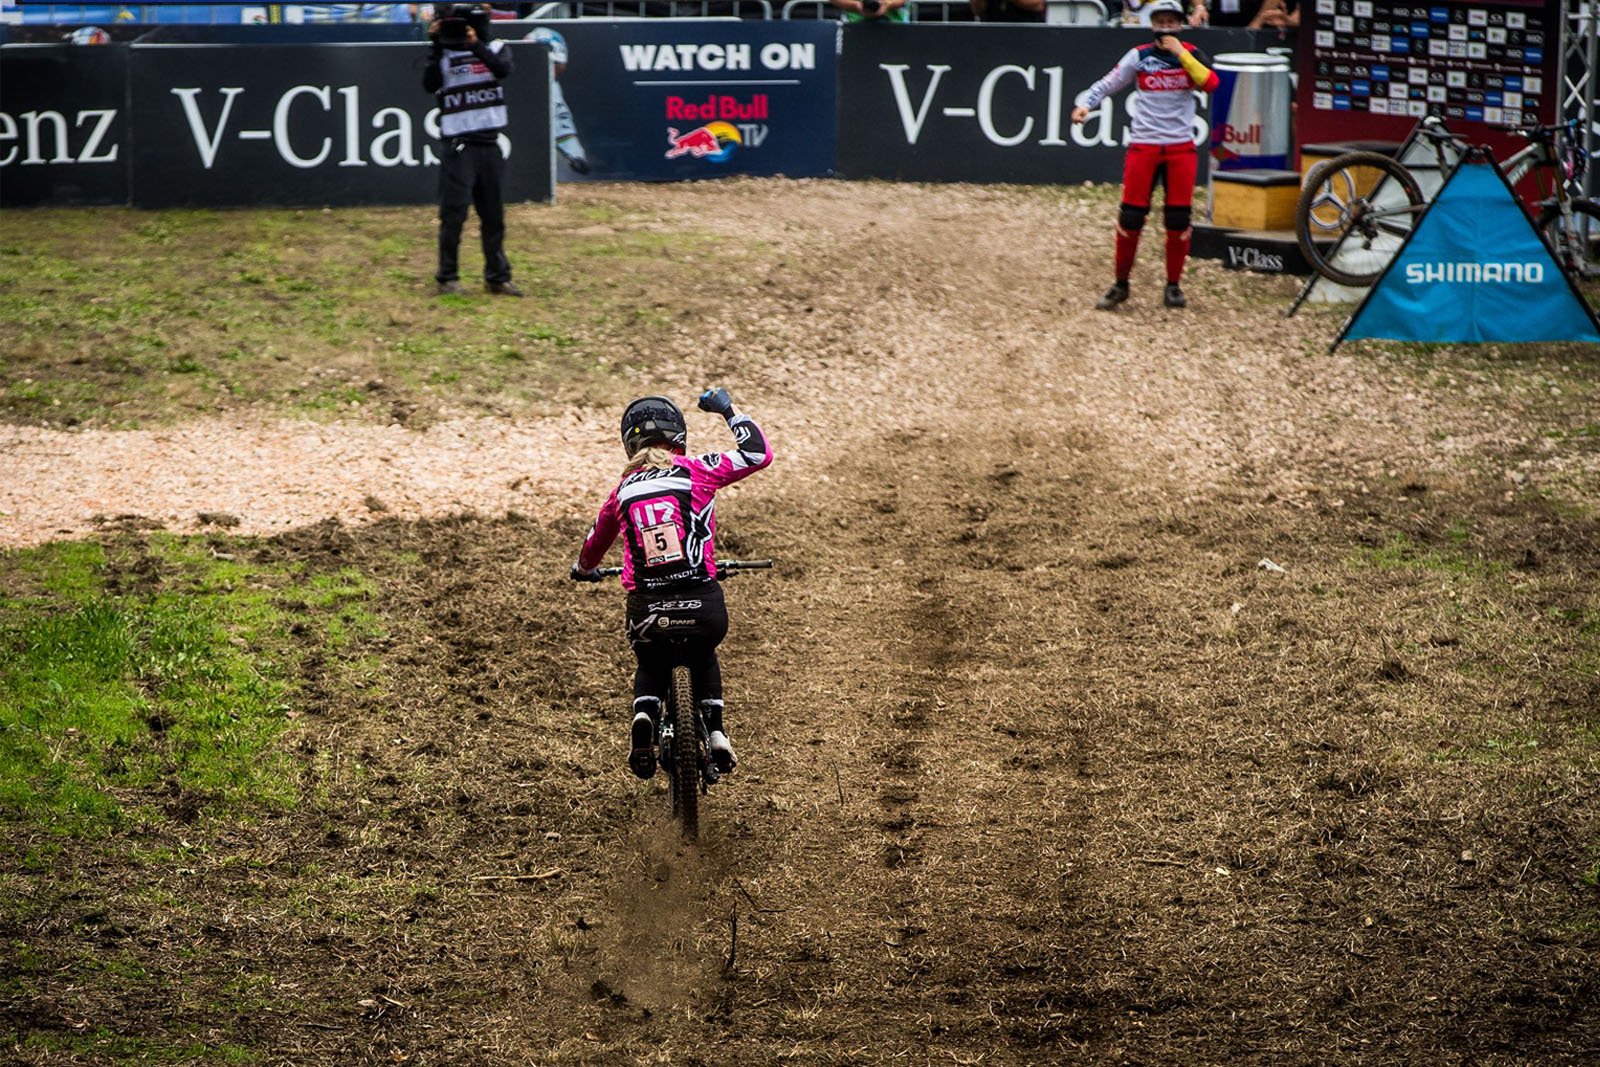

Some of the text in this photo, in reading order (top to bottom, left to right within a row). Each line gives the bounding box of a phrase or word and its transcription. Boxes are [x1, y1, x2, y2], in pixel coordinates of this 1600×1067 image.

[619, 43, 815, 72] WATCH ON
[444, 86, 504, 108] TV HOST
[666, 94, 768, 120] Red Bull
[738, 124, 768, 148] TV
[1223, 123, 1261, 144] Bull
[1228, 245, 1284, 272] V-Class
[1406, 262, 1544, 284] SHIMANO
[654, 532, 668, 552] 5
